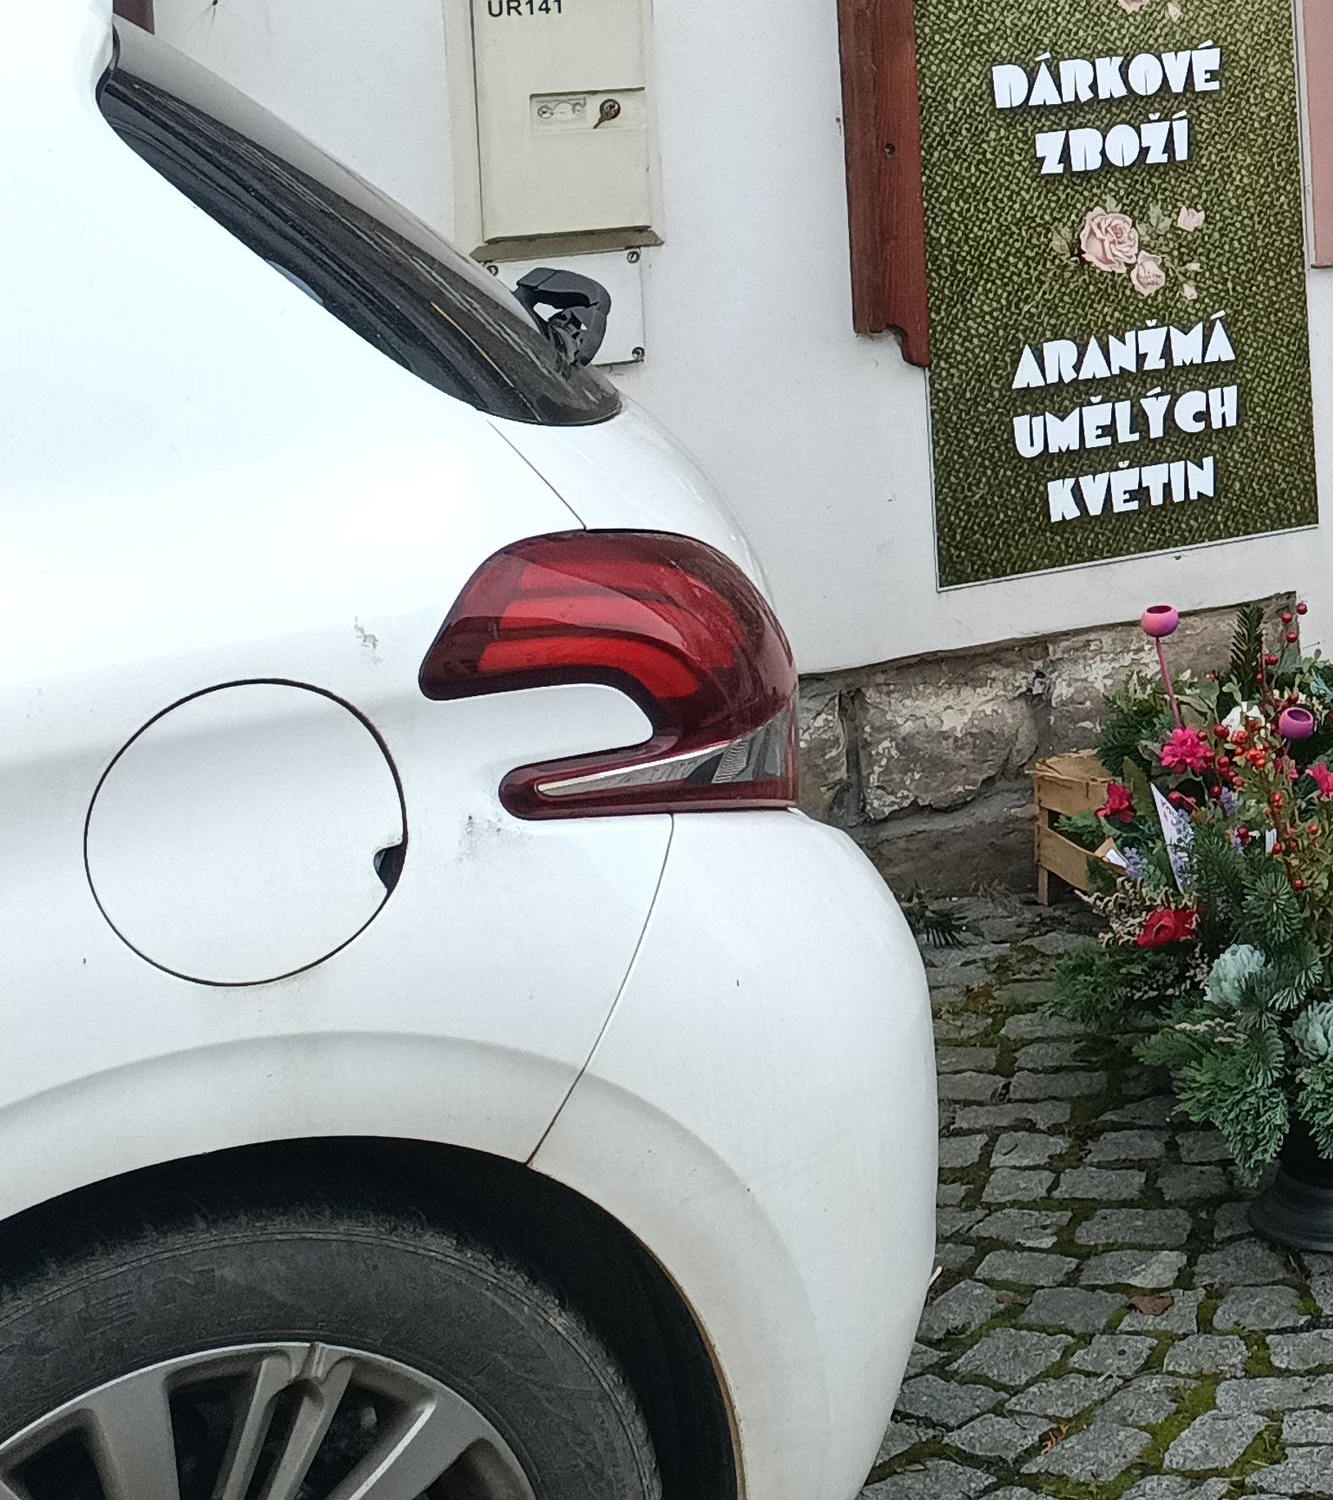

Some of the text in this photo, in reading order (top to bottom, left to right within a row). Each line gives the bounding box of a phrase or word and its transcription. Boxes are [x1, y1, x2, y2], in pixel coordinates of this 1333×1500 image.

[992, 39, 1222, 109] DÁRKOVÉ
[1034, 109, 1190, 175] ZBOŽÍ
[1011, 310, 1236, 390] ARANŽMÁ
[1012, 385, 1239, 459] UMĚLÝCH
[1046, 456, 1216, 523] KVĚTIN
